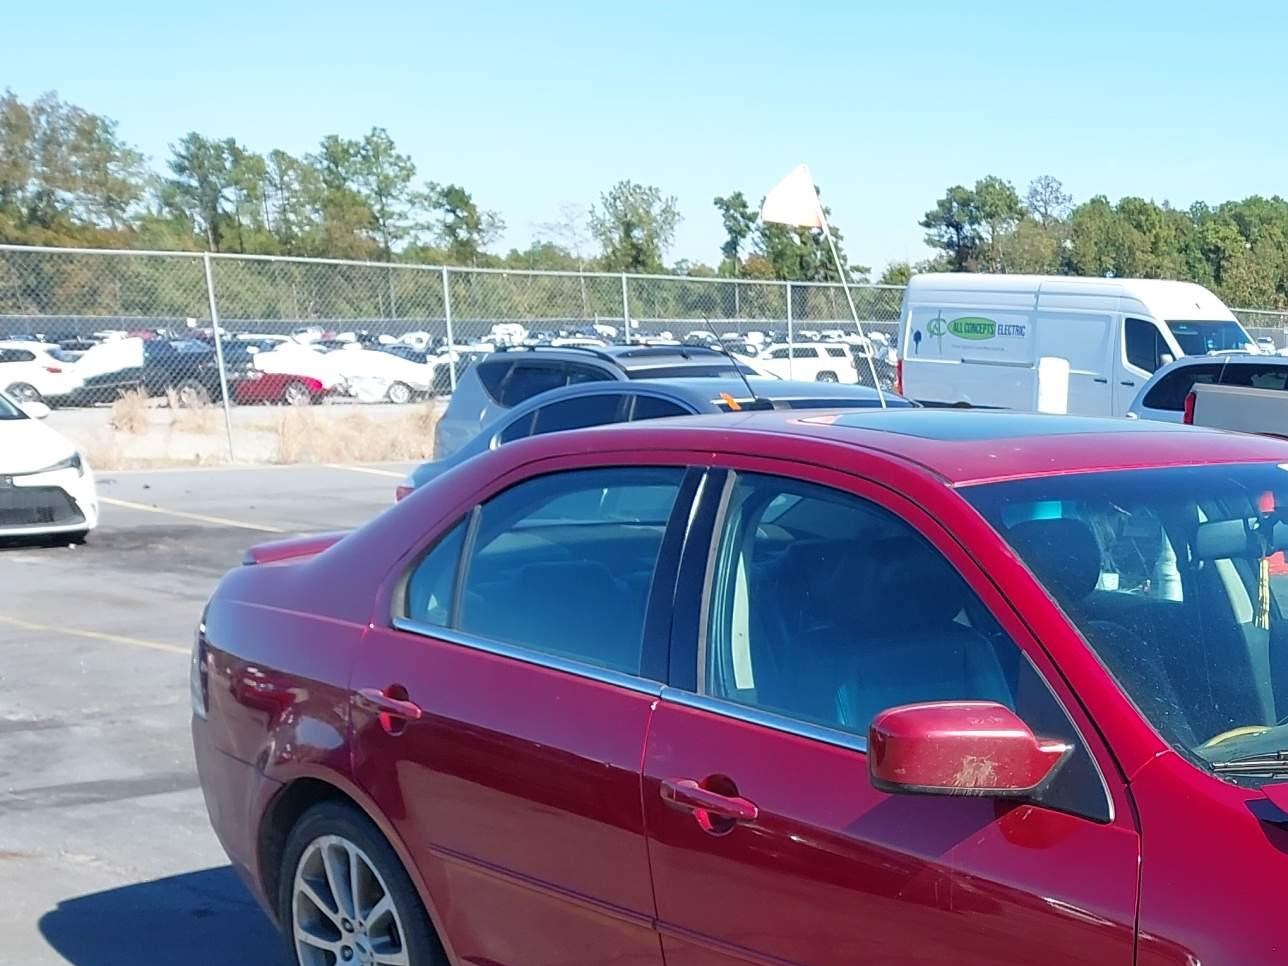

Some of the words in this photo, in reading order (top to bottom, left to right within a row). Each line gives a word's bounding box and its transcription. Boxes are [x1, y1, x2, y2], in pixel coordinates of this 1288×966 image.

[952, 321, 963, 334] ALL
[964, 322, 994, 336] CONCEPTS
[998, 324, 1026, 337] ELECTRIC
